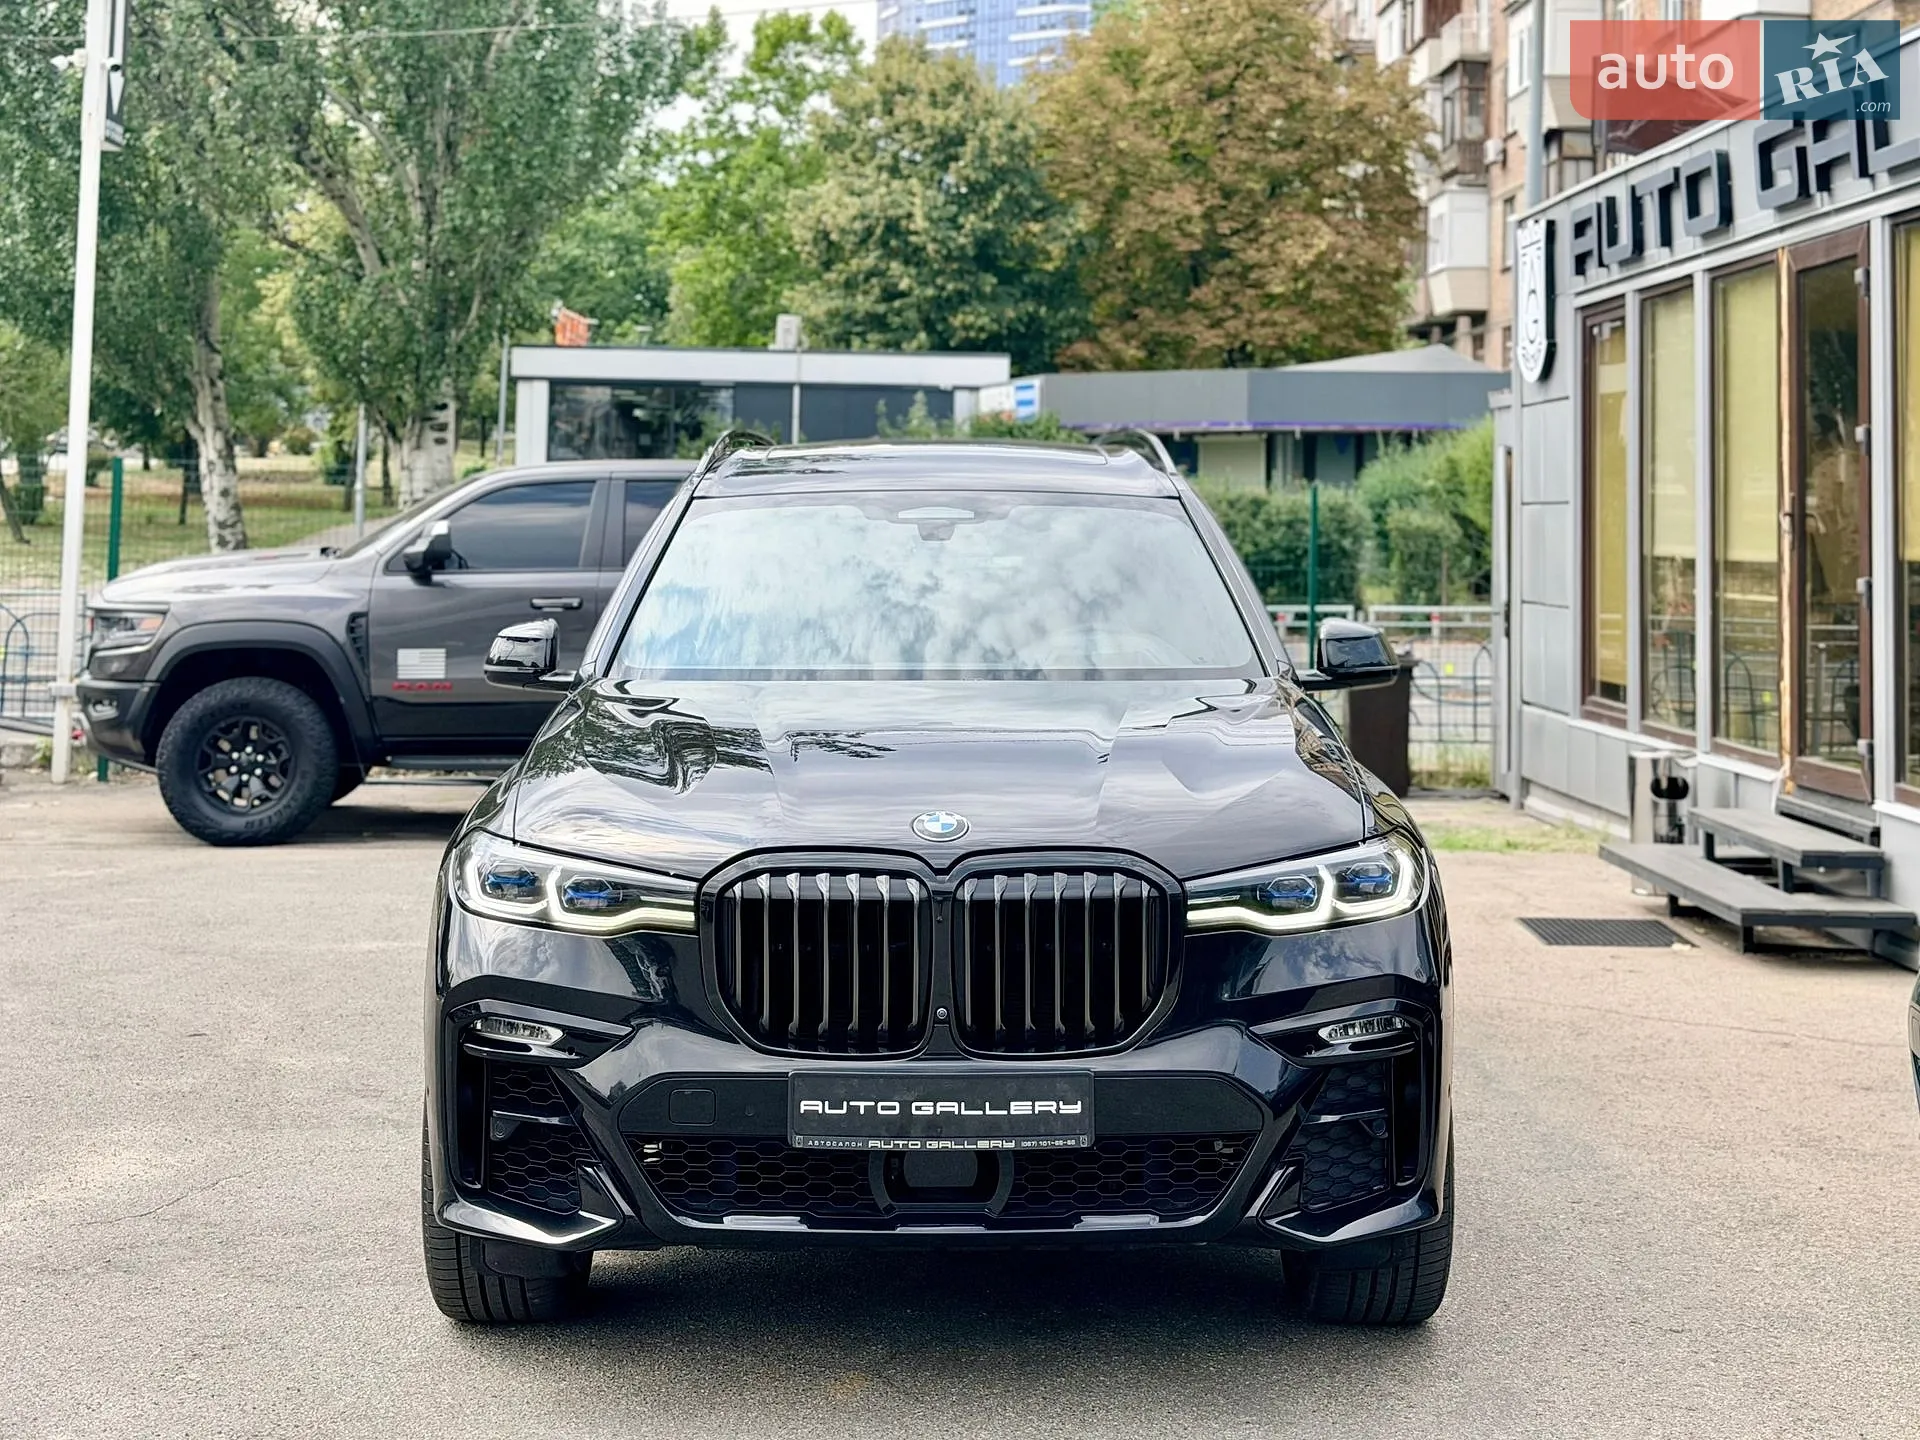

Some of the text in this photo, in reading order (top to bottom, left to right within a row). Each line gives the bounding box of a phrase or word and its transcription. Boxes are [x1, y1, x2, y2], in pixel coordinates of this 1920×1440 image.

[1570, 149, 1734, 279] AUTO
[800, 1100, 1082, 1115] AUTO GALLERY
[868, 1140, 921, 1149] AUTO
[926, 1140, 1015, 1149] GALLERY
